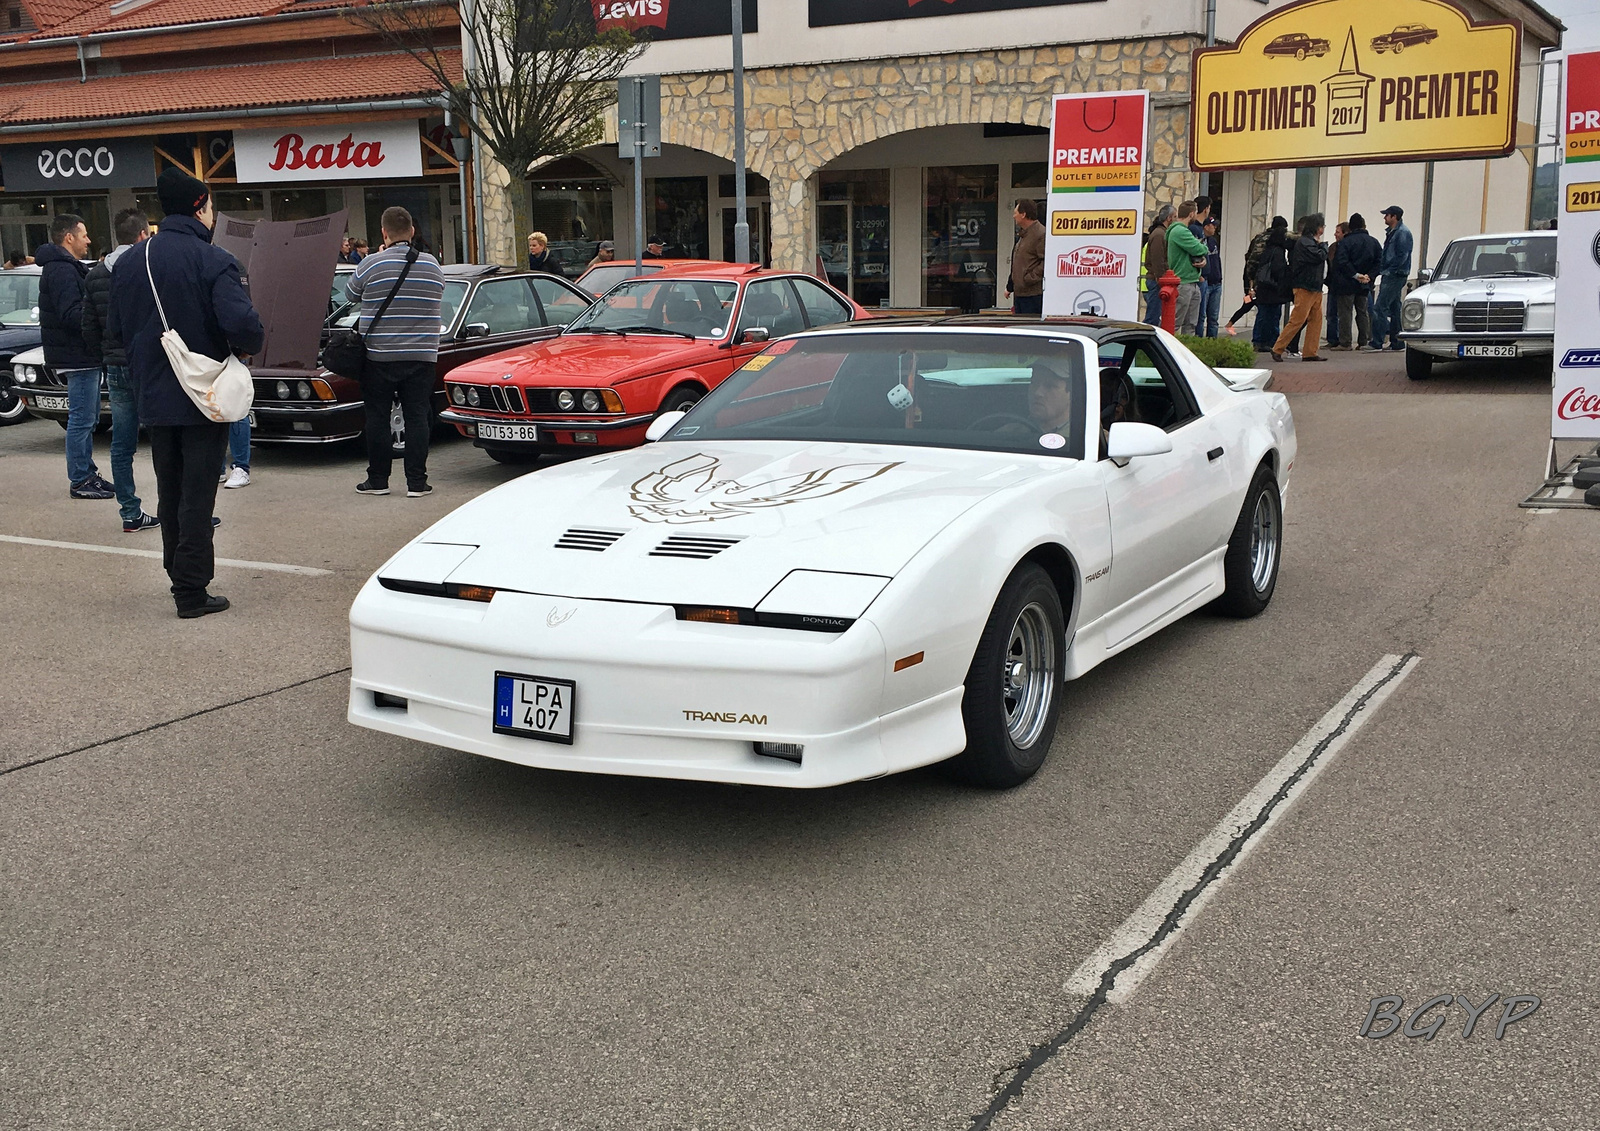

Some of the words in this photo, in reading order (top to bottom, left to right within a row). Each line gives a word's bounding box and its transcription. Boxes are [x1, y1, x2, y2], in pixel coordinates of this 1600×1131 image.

[1207, 84, 1316, 135] OLDTIMER
[1332, 106, 1362, 125] 2017
[269, 133, 386, 171] Bata
[38, 147, 114, 178] ecco
[1055, 173, 1092, 181] OUTLET
[1096, 171, 1139, 180] BUDAPEST
[1056, 218, 1079, 229] 2017
[1080, 217, 1114, 230] április
[1116, 217, 1132, 229] 22.
[1071, 252, 1079, 263] 19
[1105, 252, 1113, 263] 89
[1060, 259, 1075, 275] MINI
[1076, 266, 1091, 275] CLUB
[1092, 259, 1123, 275] HUNGARY
[1466, 347, 1514, 356] KLR-626
[802, 616, 846, 626] PONTIAC
[521, 683, 563, 709] LPA
[501, 705, 509, 717] H
[682, 710, 736, 723] TRANS
[738, 713, 767, 725] AM
[523, 707, 559, 730] 407
